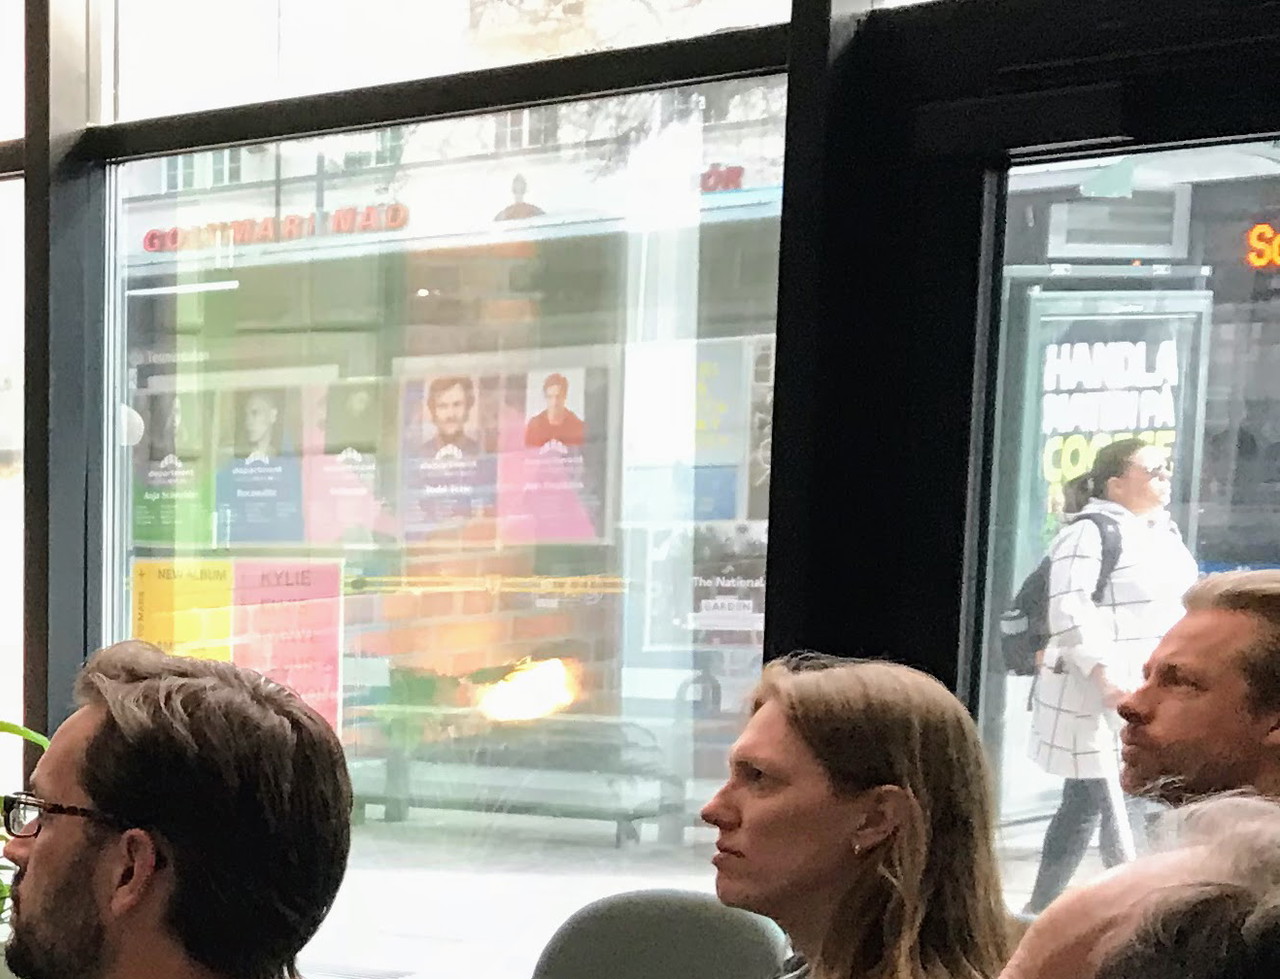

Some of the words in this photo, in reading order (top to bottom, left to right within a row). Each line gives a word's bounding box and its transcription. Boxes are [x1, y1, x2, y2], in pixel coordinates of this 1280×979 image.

[260, 570, 312, 587] KYLIE
[693, 576, 713, 587] The
[715, 575, 765, 588] National
